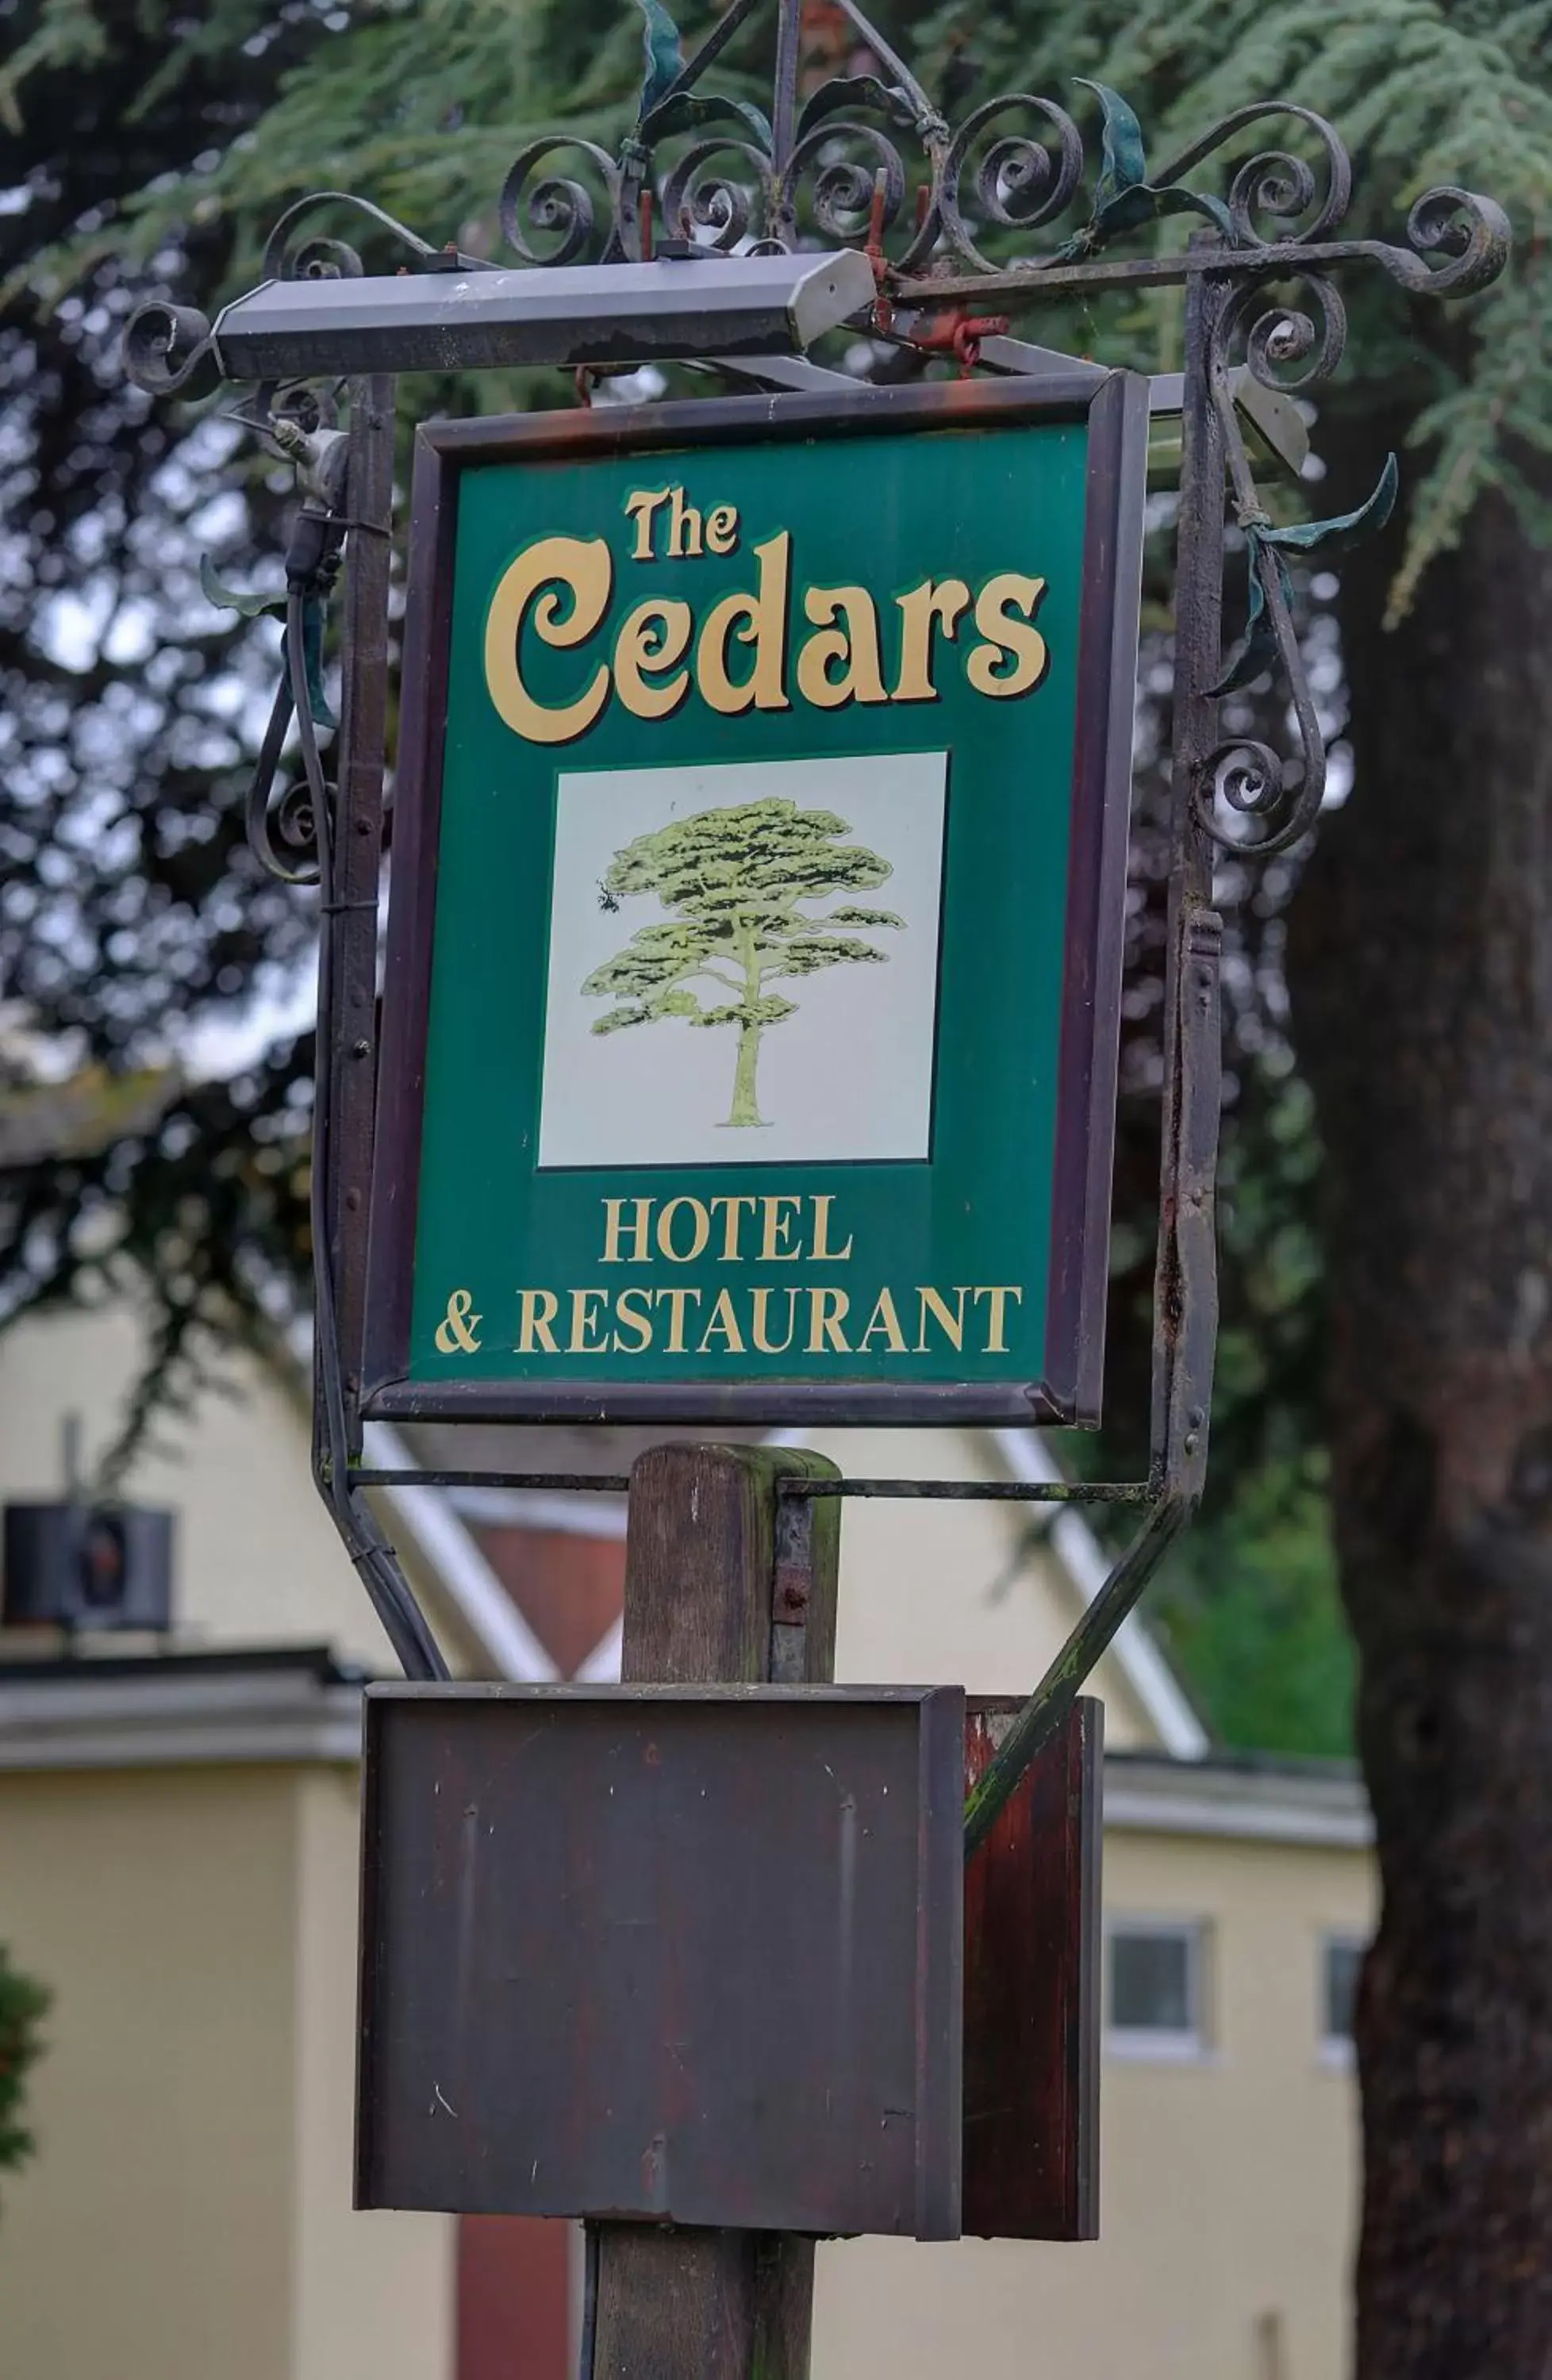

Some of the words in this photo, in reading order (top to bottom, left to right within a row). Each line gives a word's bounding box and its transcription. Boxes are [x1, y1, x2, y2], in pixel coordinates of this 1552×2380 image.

[624, 486, 738, 560] The
[484, 529, 1047, 742] Cedars
[598, 1195, 853, 1262] HOTEL
[435, 1288, 482, 1354] &
[513, 1286, 1024, 1355] RESTAURANT
